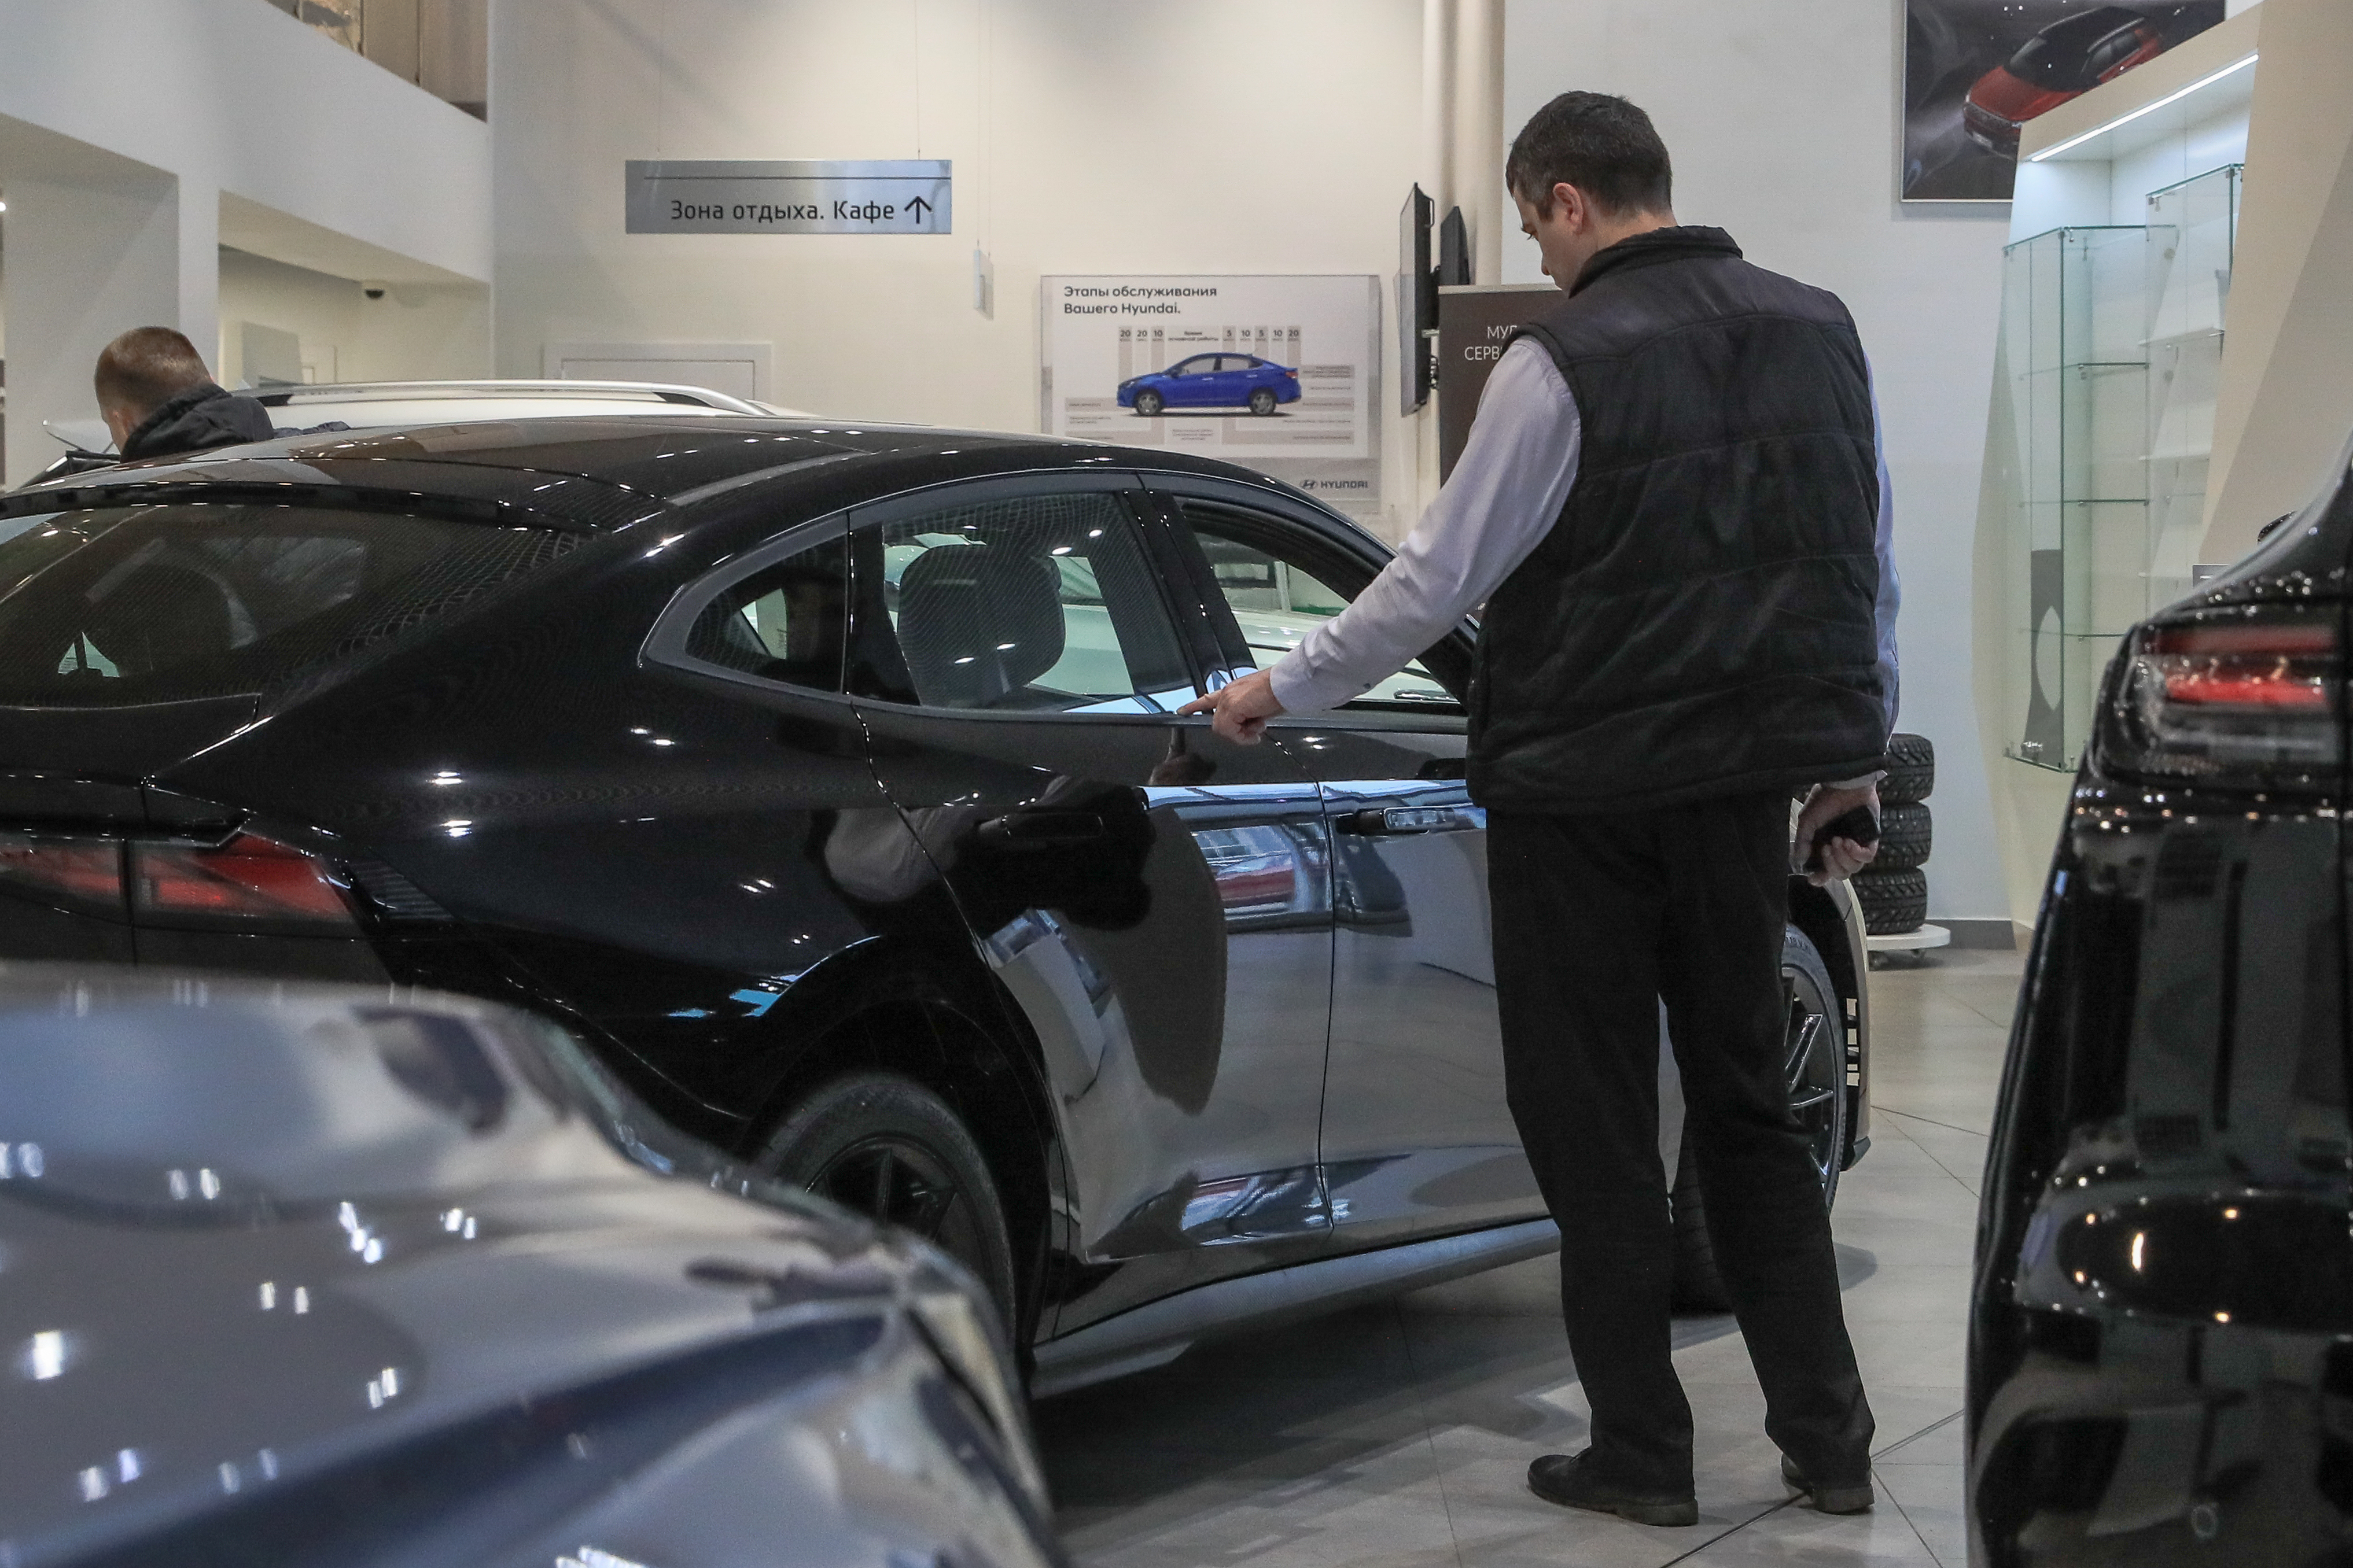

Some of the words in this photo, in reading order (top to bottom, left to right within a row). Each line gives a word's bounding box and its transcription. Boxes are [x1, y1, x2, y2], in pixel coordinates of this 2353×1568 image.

[671, 200, 724, 220] Зона
[732, 204, 824, 224] отдыха.
[834, 200, 894, 224] Кафе
[1064, 286, 1109, 297] Этапы
[1112, 286, 1217, 299] обслуживания
[1064, 303, 1118, 314] Вашего
[1121, 302, 1181, 316] Hyundai.
[1464, 346, 1503, 360] СЕРВ
[1320, 480, 1369, 489] HYUNDAI
